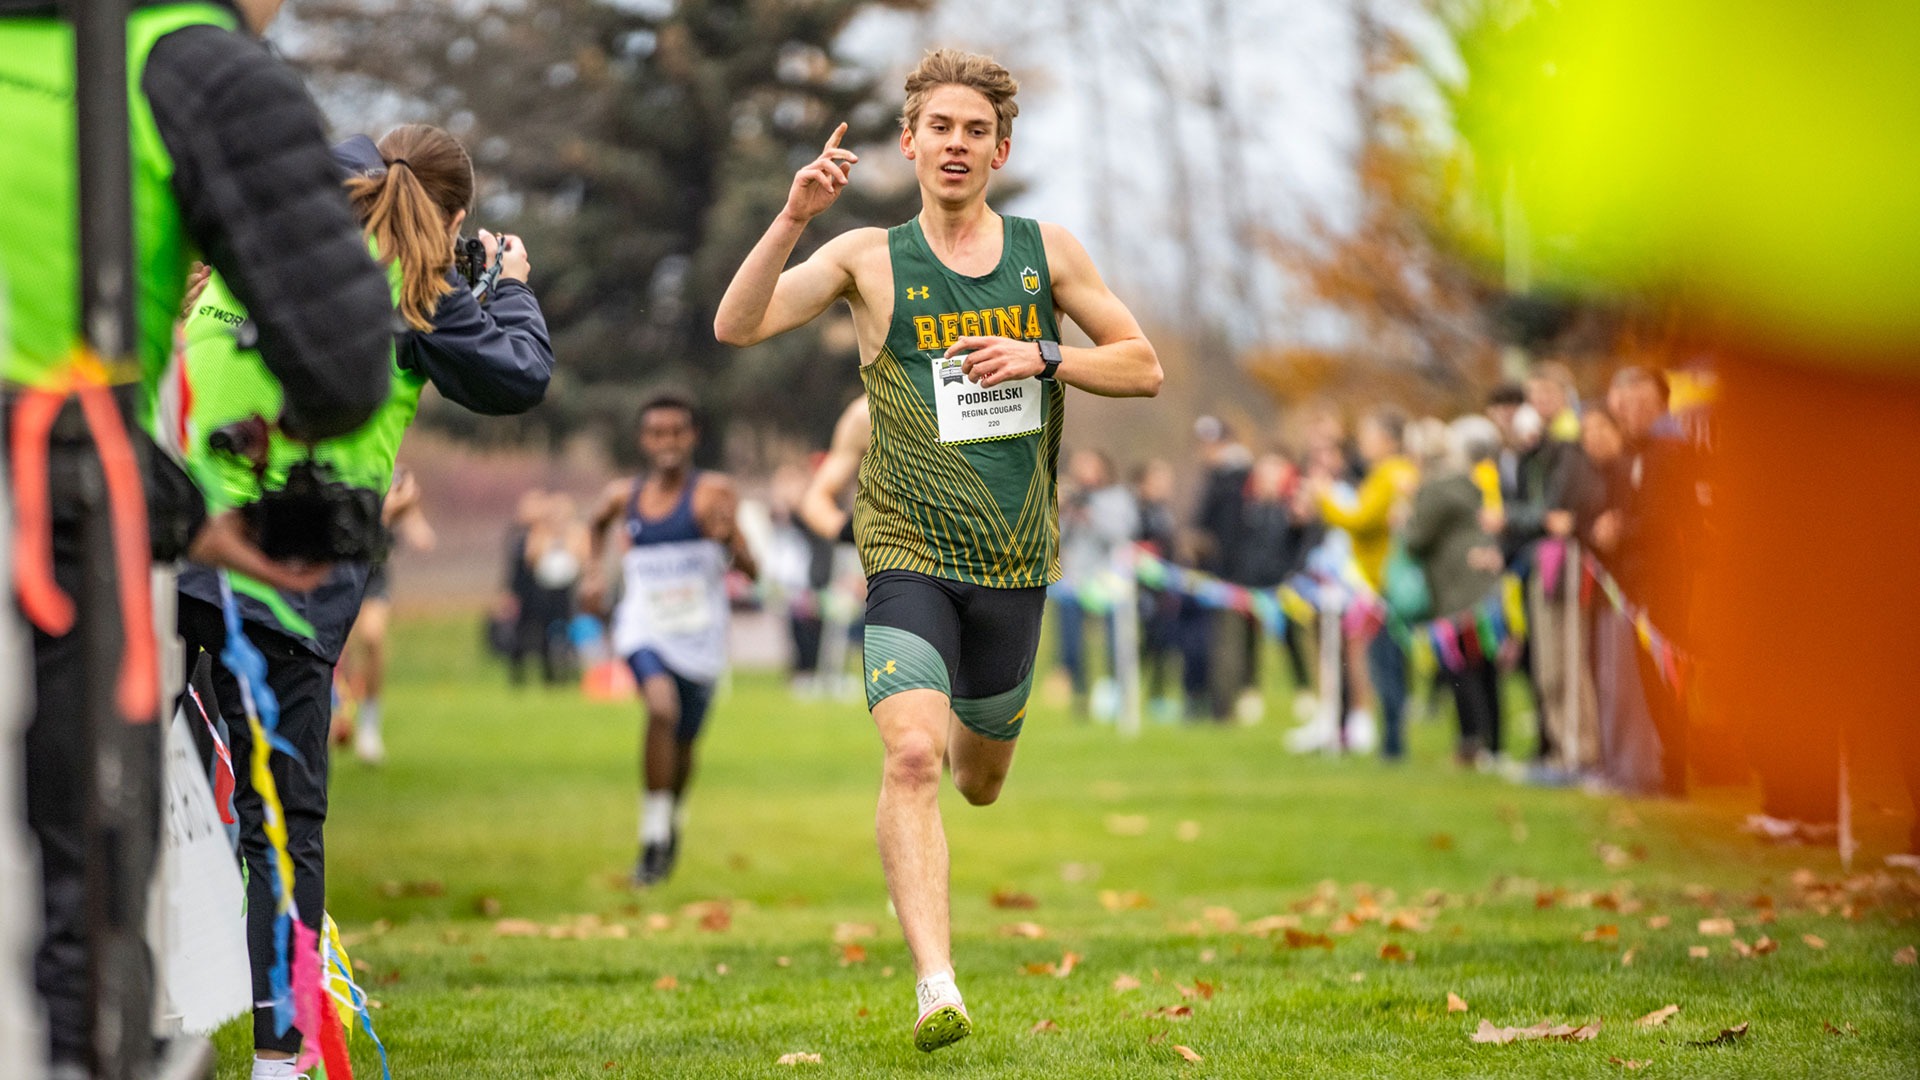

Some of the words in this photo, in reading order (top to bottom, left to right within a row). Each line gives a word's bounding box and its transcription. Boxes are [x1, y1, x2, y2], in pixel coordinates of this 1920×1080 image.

[913, 304, 1042, 351] REGINA
[957, 387, 1023, 405] PODBIELSKI
[962, 408, 988, 418] REGINA
[989, 404, 1022, 415] COUGARS
